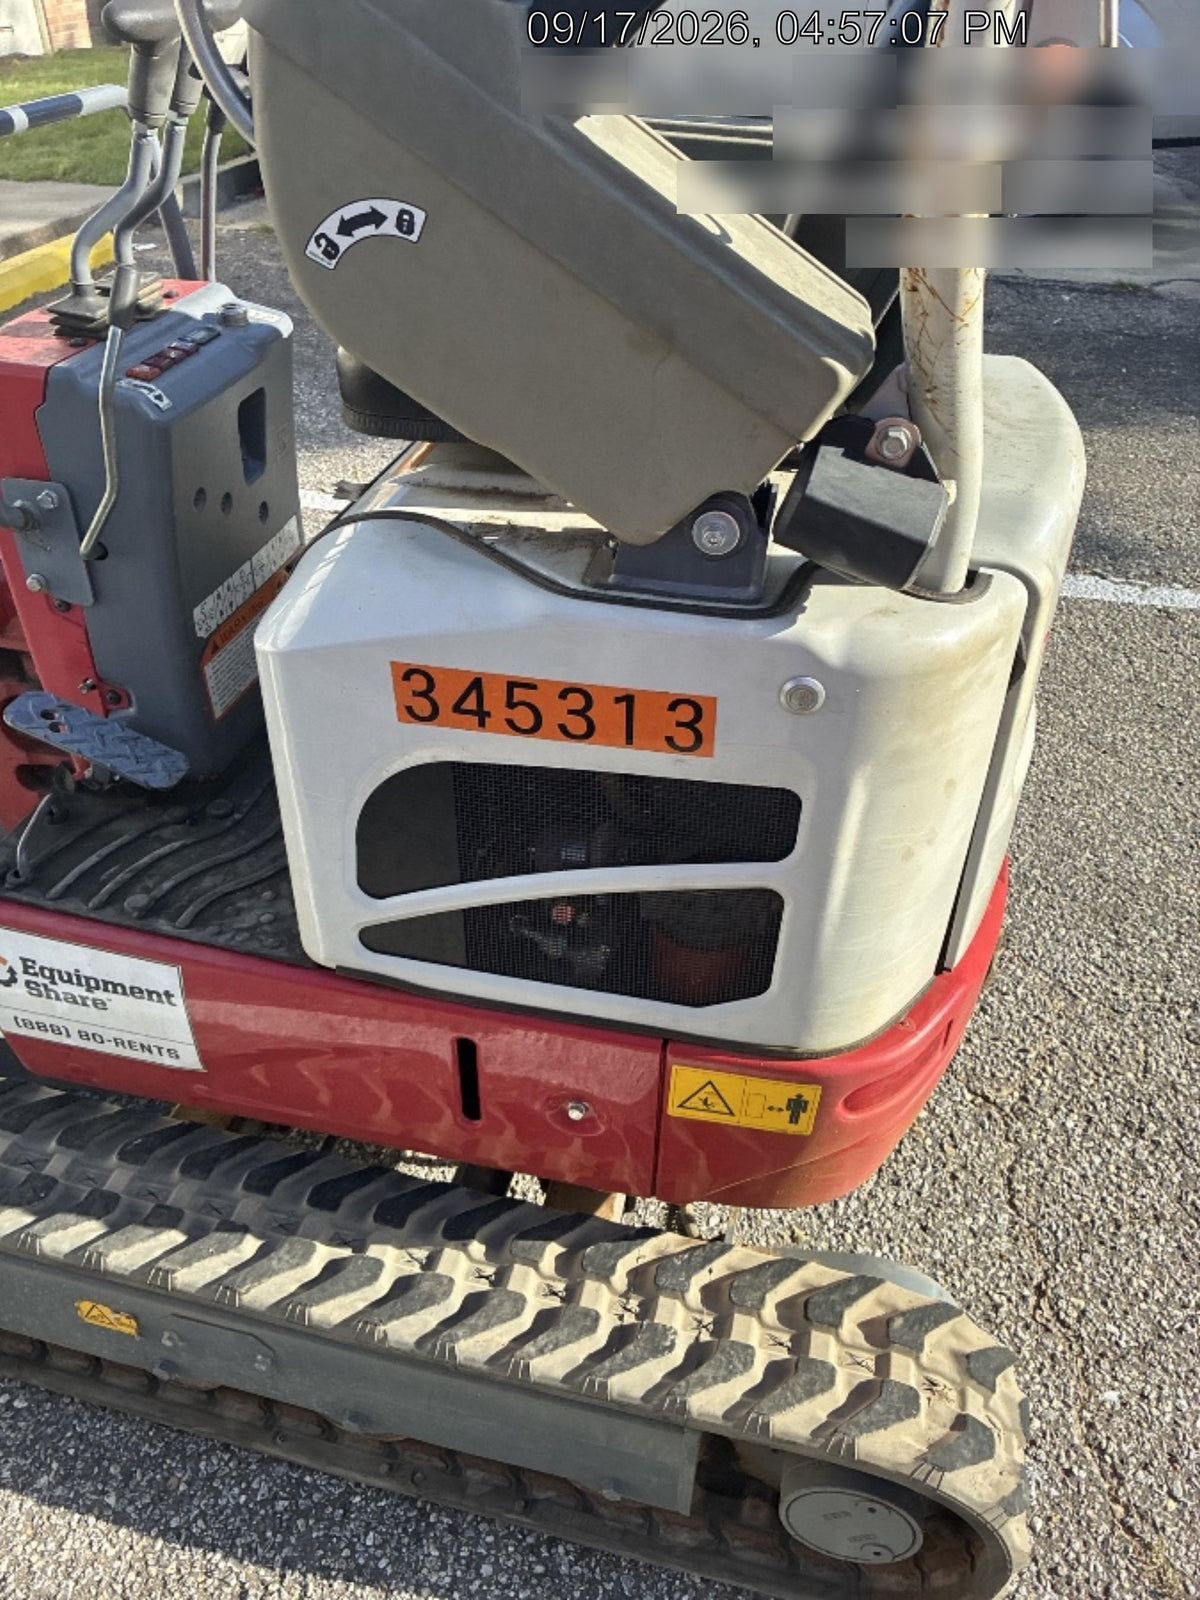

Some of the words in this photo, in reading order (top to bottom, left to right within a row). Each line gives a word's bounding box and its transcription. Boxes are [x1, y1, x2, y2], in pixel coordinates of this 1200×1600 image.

[401, 667, 704, 753] 345313
[19, 956, 178, 1007] Equipment
[25, 979, 109, 1011] Share
[14, 1015, 71, 1039] (888)
[77, 1029, 181, 1060] 80-RENTS
